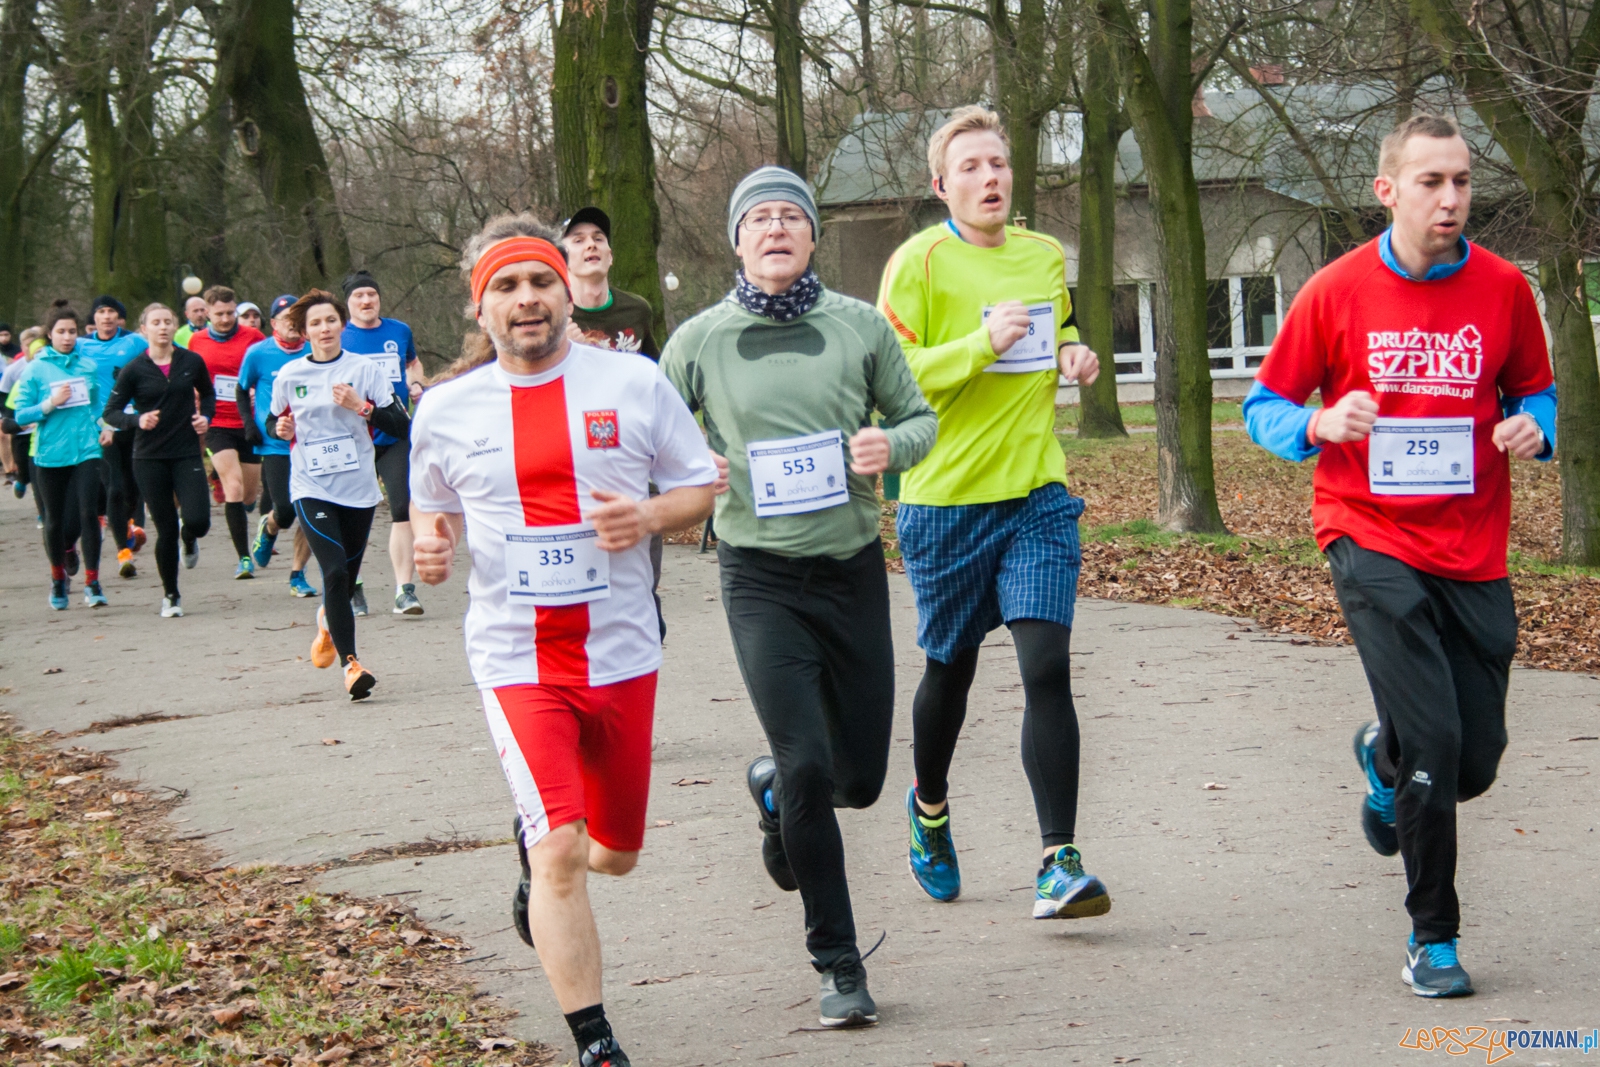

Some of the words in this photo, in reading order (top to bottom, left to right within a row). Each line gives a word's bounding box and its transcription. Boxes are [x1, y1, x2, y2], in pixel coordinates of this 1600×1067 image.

[1367, 327, 1465, 351] DRUŻYNA
[1368, 350, 1483, 380] SZPIKU
[1374, 382, 1475, 400] www.darszpiku.pl
[322, 444, 339, 455] 368
[1406, 440, 1440, 456] 259
[783, 457, 816, 476] 553
[539, 548, 575, 566] 335
